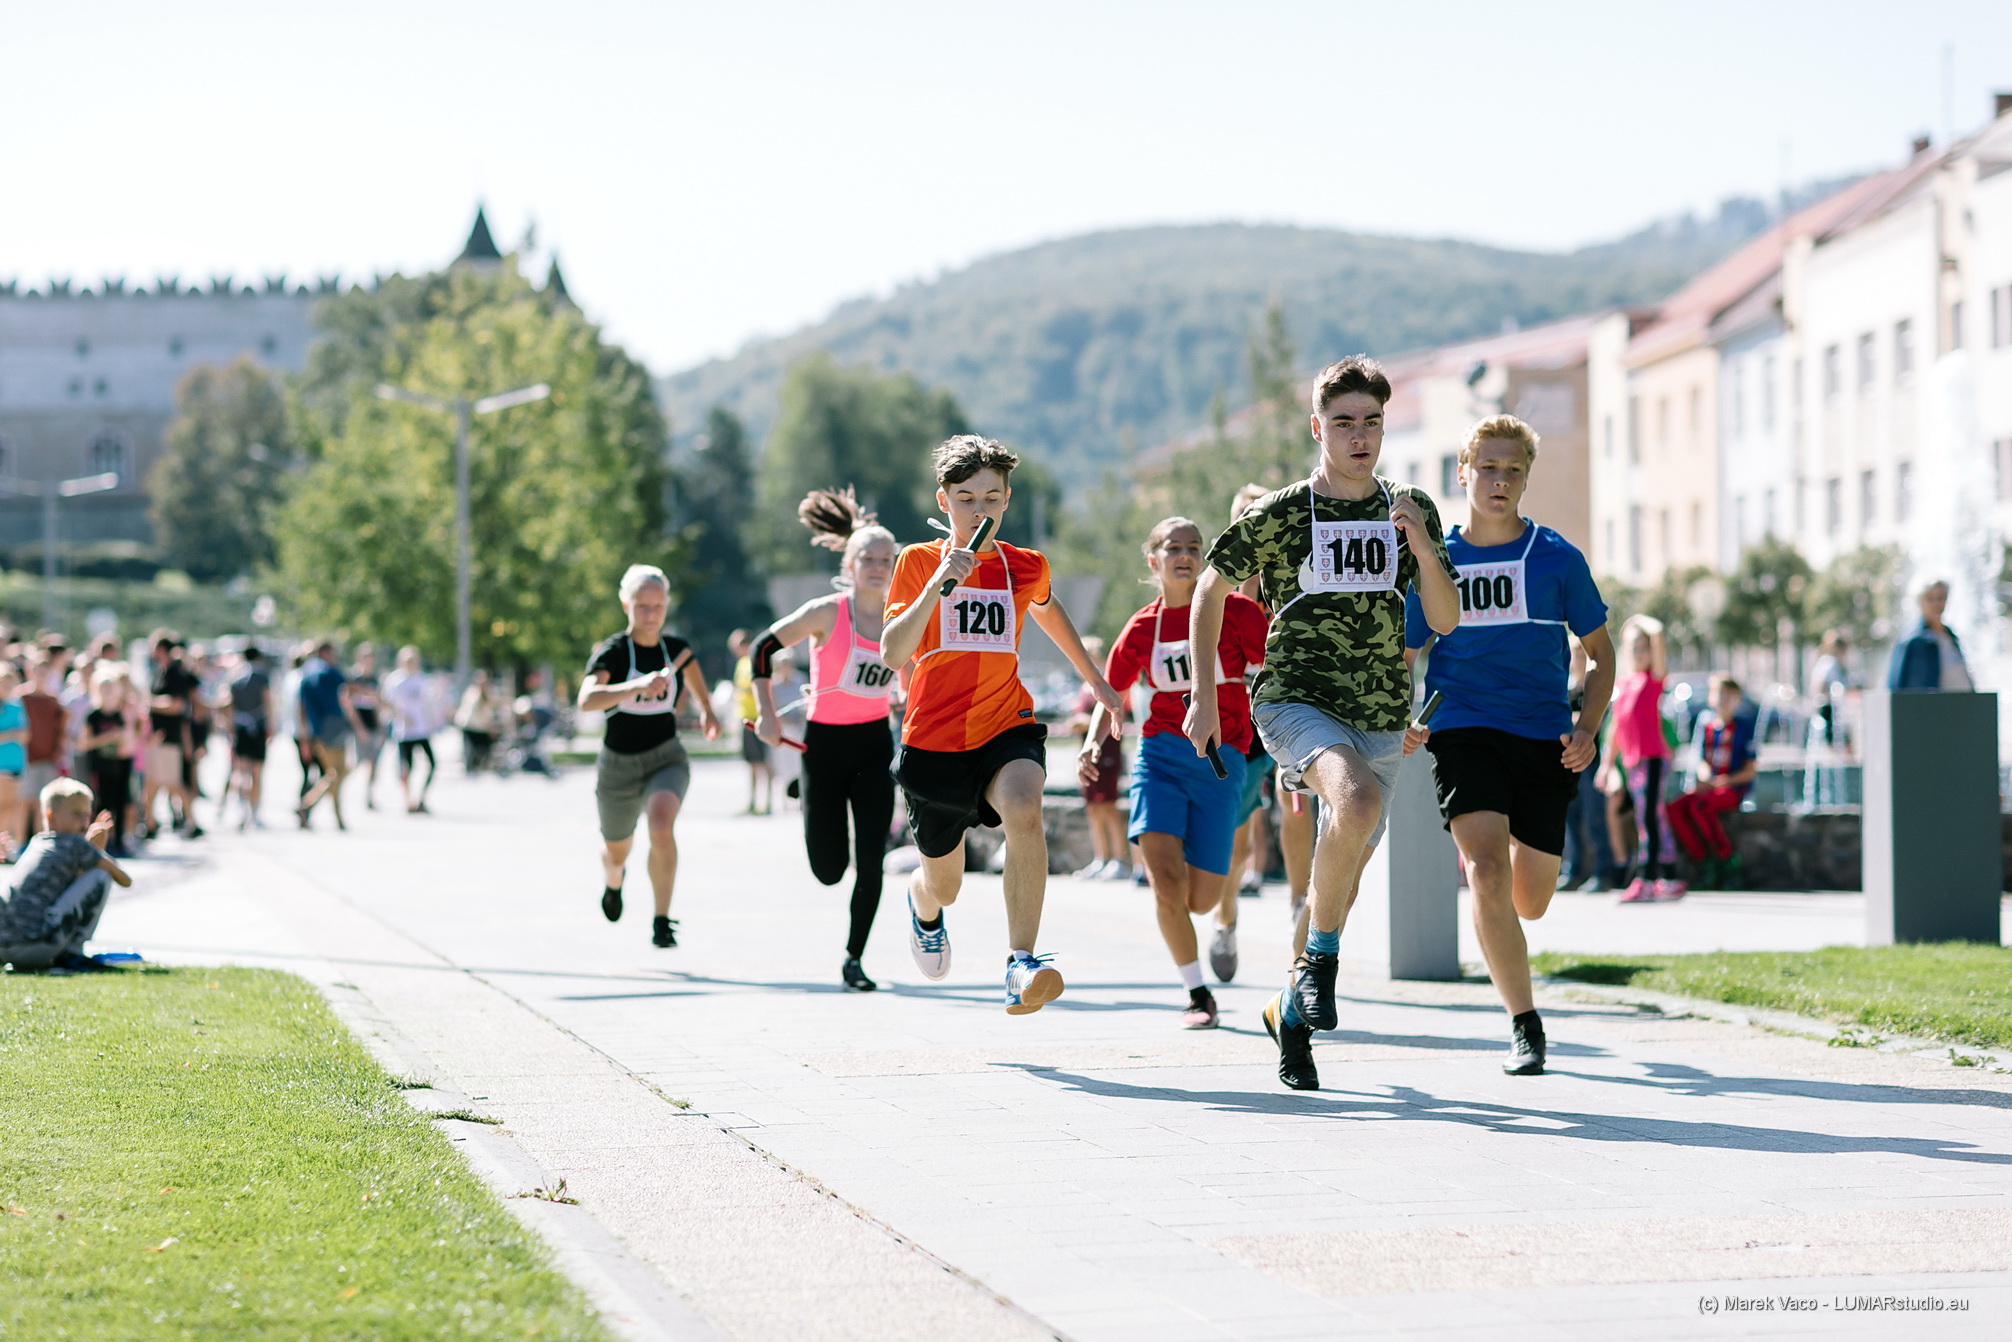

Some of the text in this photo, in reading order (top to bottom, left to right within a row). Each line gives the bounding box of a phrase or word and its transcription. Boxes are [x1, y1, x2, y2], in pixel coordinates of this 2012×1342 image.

[1327, 538, 1386, 575] 140
[1457, 575, 1513, 611] 100
[954, 600, 1006, 636] 120
[855, 662, 895, 687] 160
[1163, 654, 1193, 683] 11
